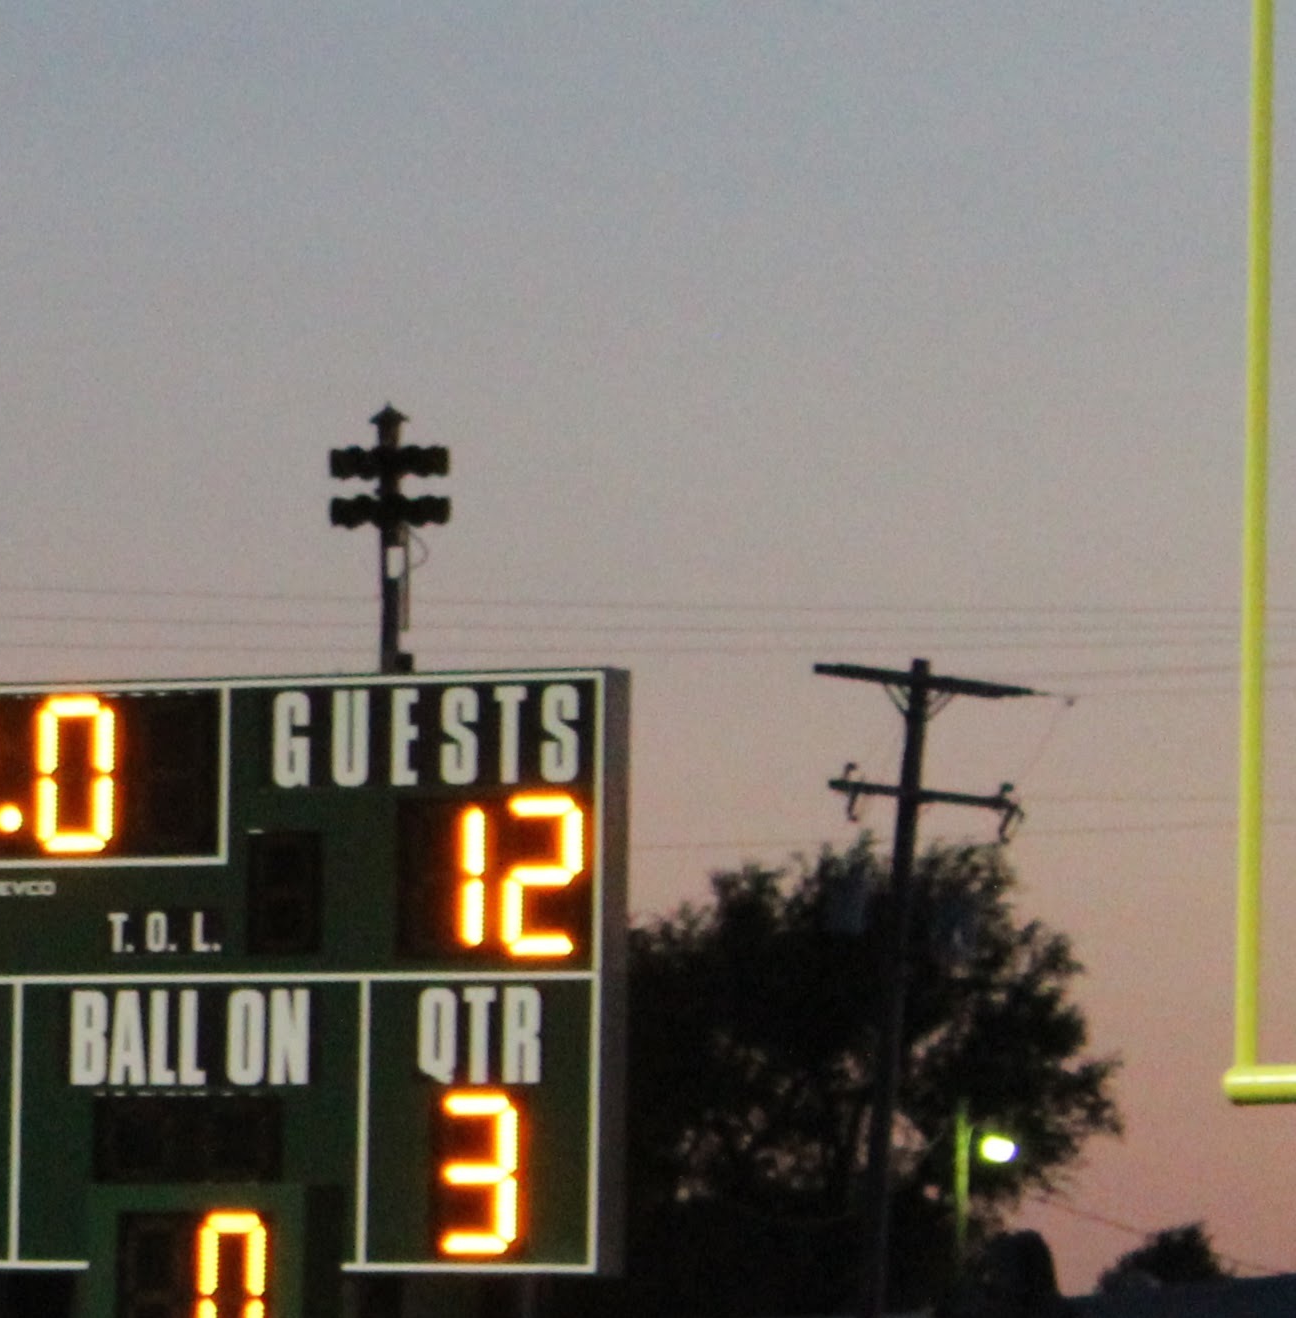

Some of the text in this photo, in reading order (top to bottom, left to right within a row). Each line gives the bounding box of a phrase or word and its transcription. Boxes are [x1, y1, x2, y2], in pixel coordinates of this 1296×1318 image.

[271, 684, 581, 789] GUESTS
[459, 795, 584, 958] 12
[69, 987, 310, 1086] BALL ON
[416, 985, 542, 1085] QTR
[440, 1093, 518, 1256] 3
